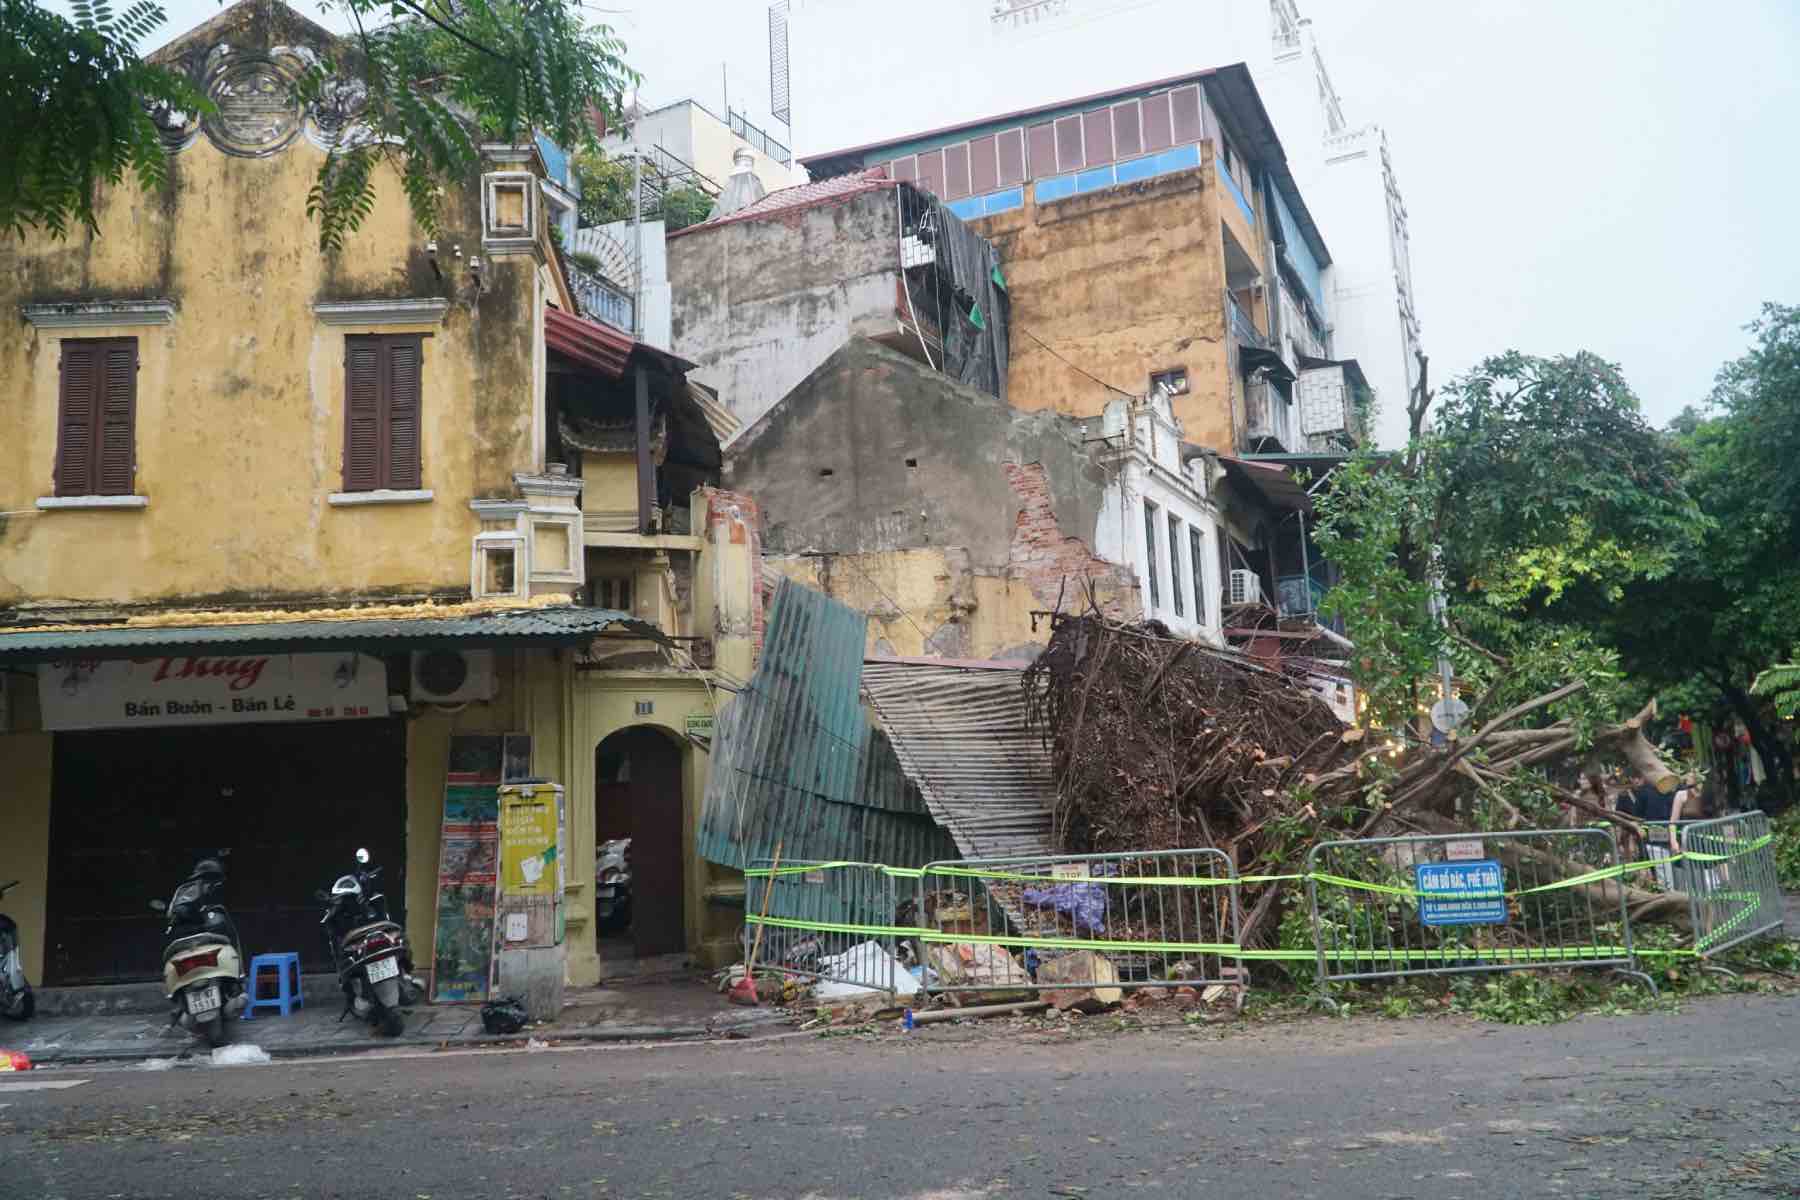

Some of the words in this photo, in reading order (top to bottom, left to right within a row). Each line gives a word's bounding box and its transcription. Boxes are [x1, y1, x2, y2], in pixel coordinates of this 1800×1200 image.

[125, 702, 160, 716] Bán
[166, 700, 212, 715] Buôn
[231, 697, 267, 712] Bán
[274, 695, 296, 711] Lẻ
